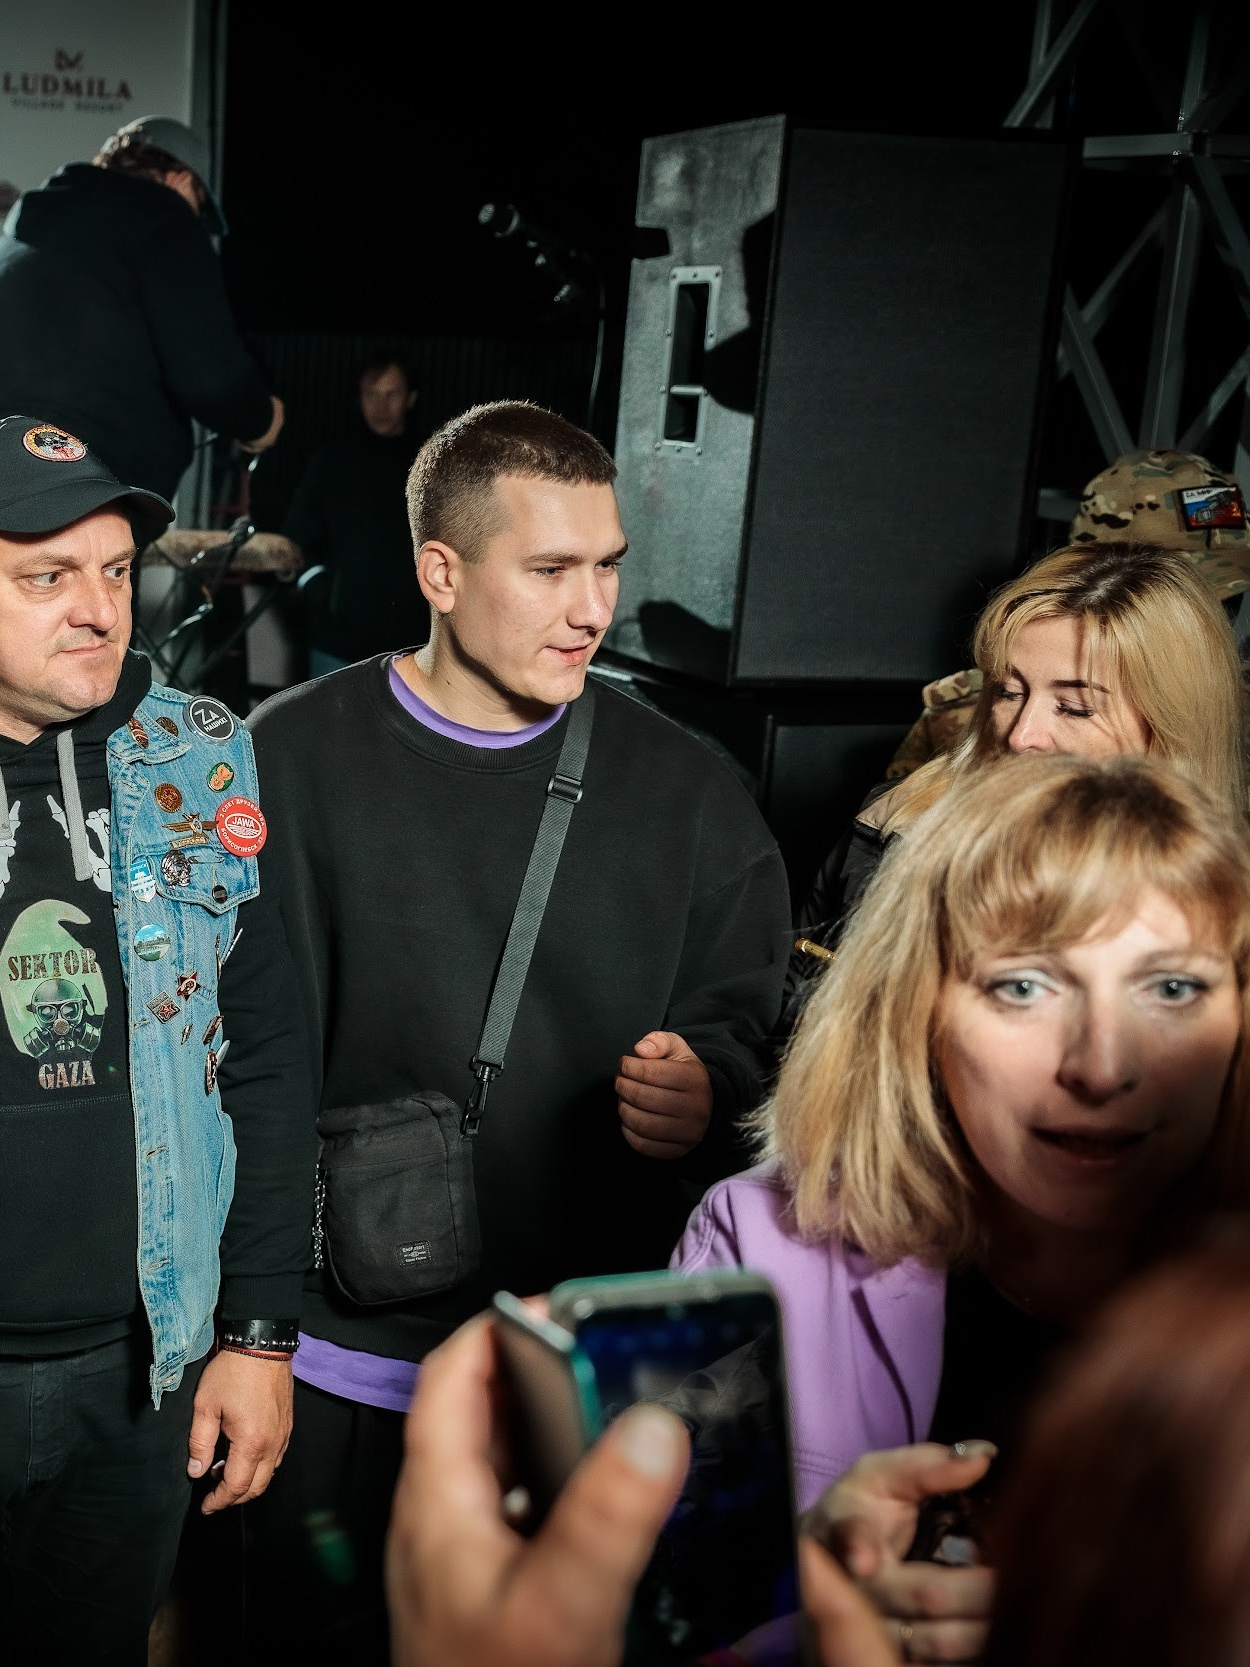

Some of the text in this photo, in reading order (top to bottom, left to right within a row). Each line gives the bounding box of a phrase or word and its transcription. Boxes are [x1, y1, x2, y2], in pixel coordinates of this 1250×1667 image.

[3, 72, 132, 102] LUDMILA
[232, 816, 255, 828] JAWA
[7, 947, 98, 981] SEKTOR
[38, 1060, 96, 1090] GAZA
